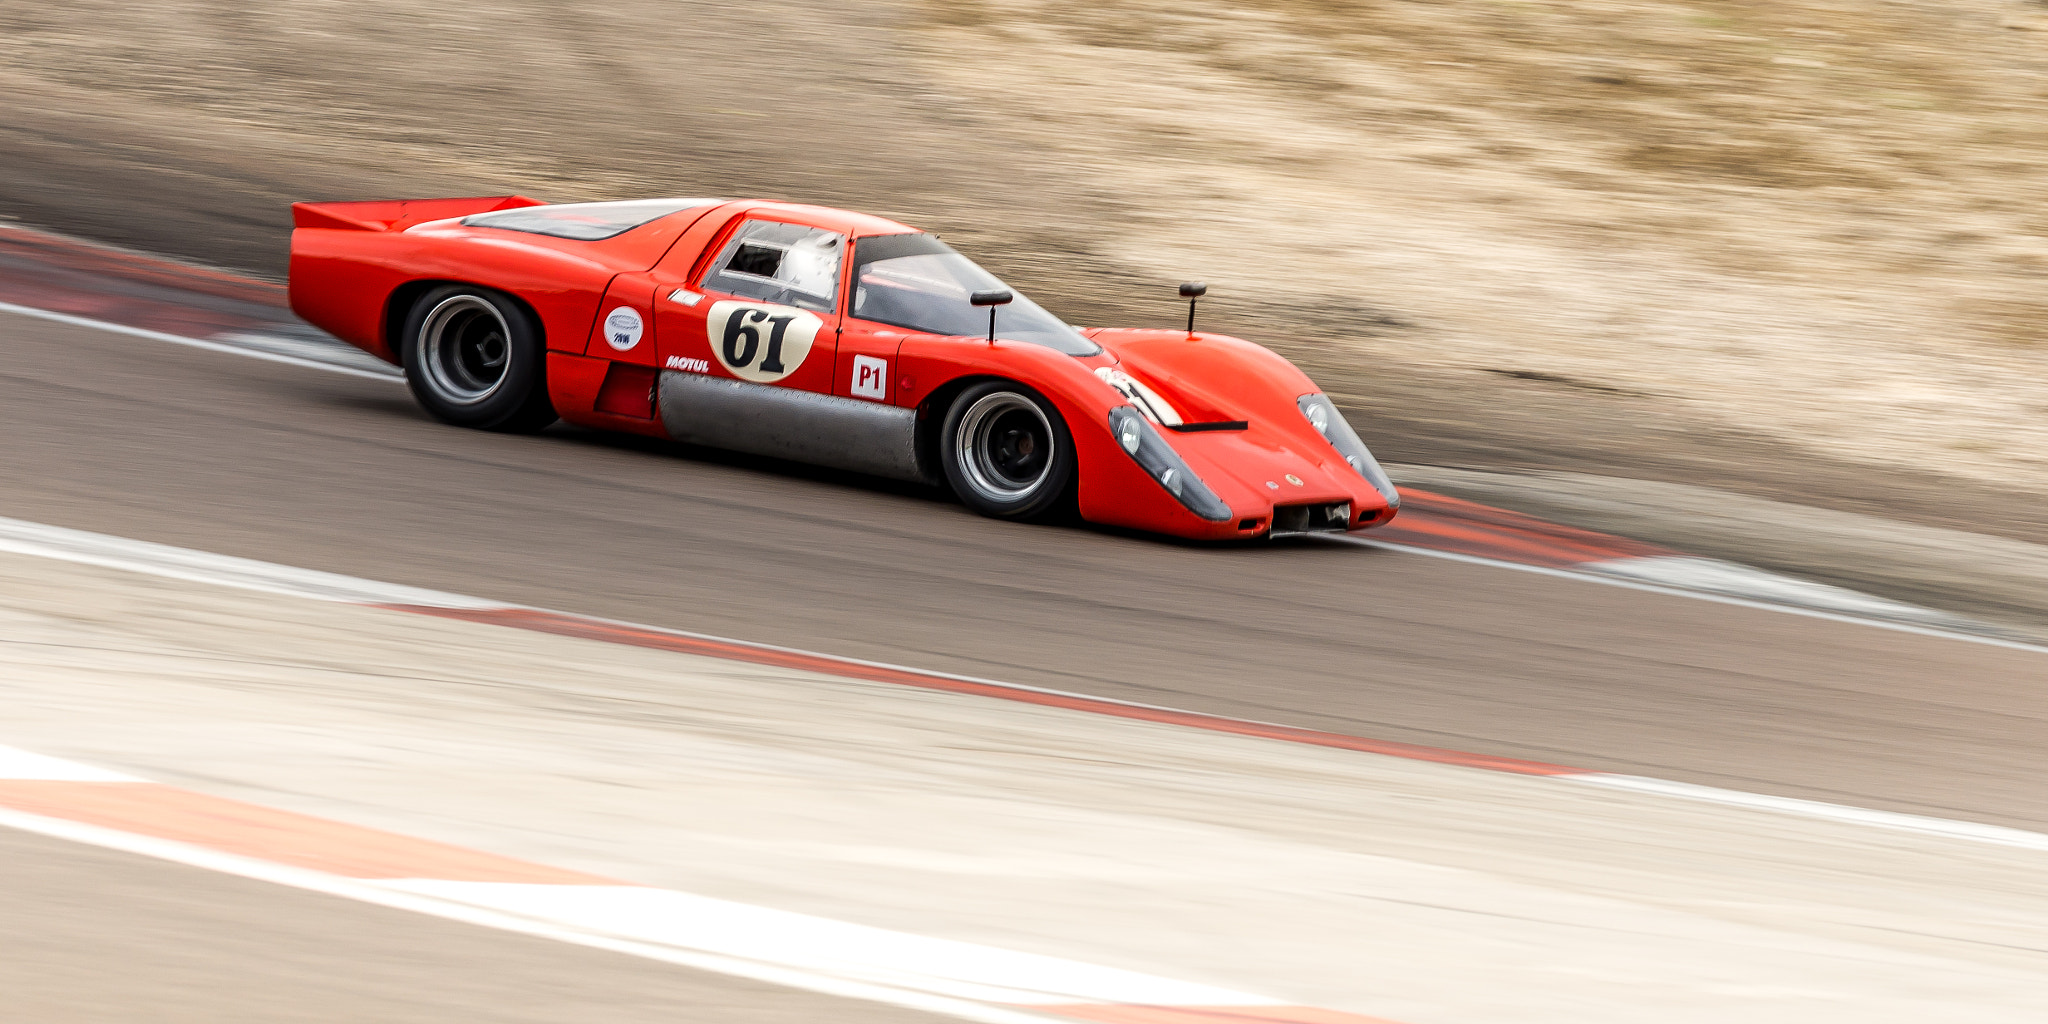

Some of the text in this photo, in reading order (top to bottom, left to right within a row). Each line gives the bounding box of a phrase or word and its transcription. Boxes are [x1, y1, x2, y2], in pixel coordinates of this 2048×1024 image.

[722, 308, 798, 374] 61
[665, 355, 709, 373] MOTUL
[858, 363, 880, 390] P1
